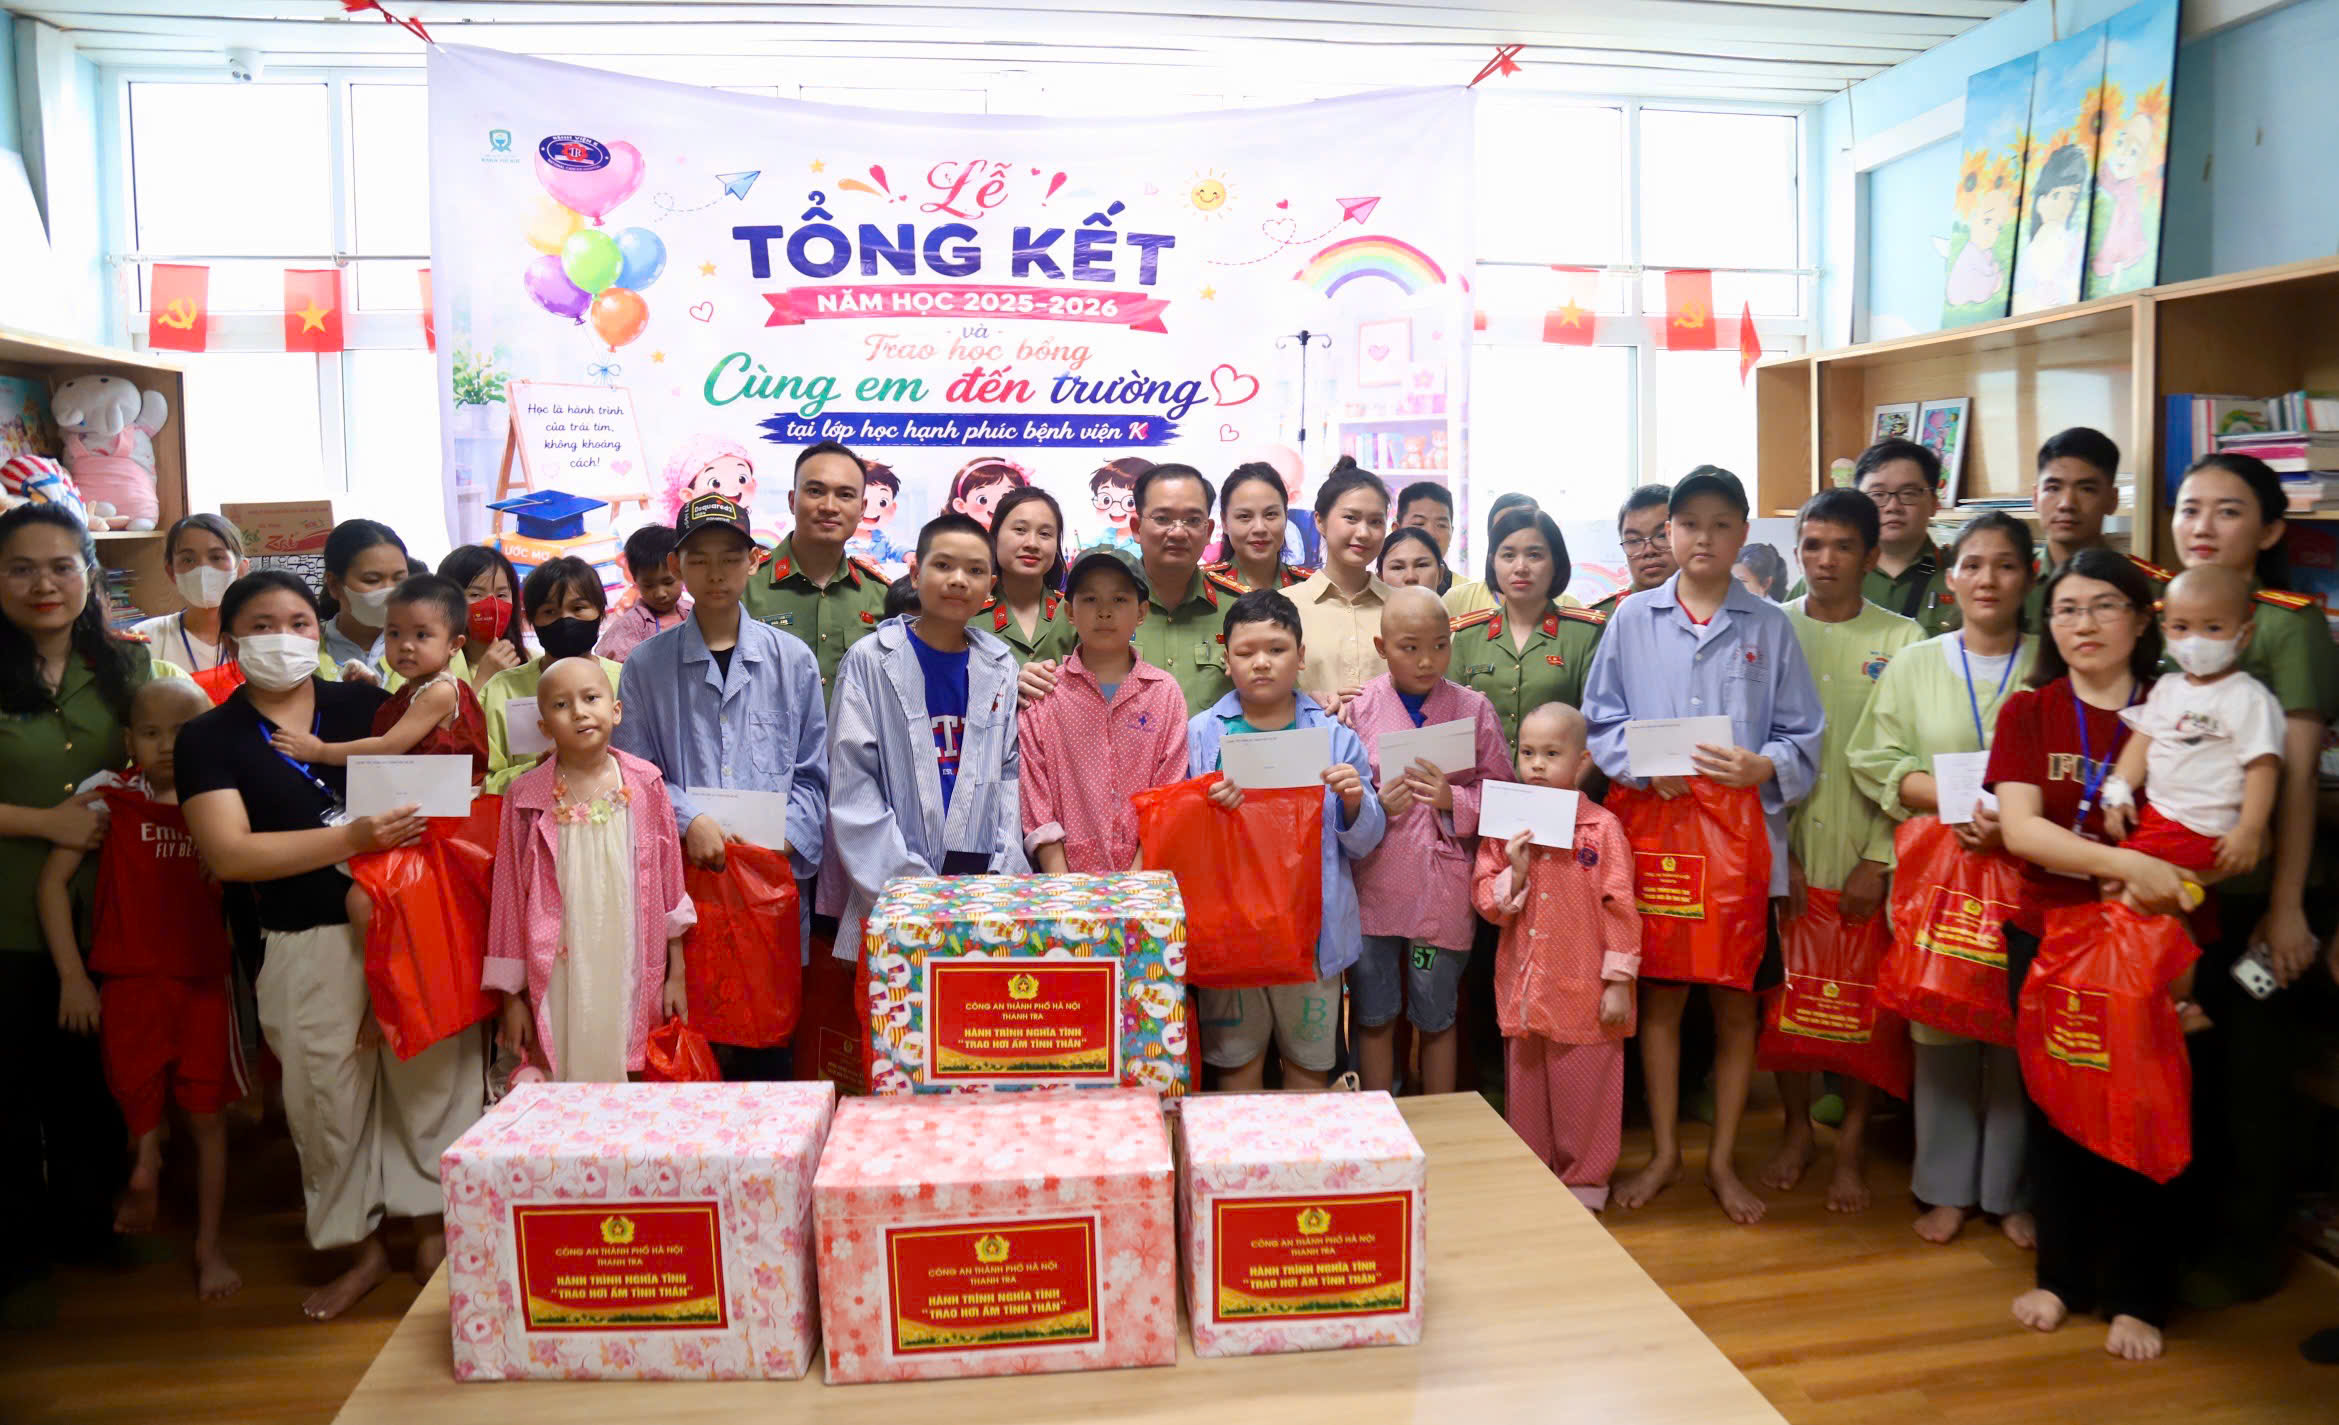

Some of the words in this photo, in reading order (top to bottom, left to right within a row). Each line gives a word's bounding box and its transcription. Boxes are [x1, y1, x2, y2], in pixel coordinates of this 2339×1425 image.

[920, 159, 1012, 220] Lễ
[732, 190, 982, 279] TỔNG
[1012, 200, 1177, 286] KẾT
[818, 289, 886, 313] NĂM
[892, 291, 953, 316] HỌC
[964, 291, 1119, 318] 2025-2026
[962, 322, 989, 339] và
[864, 333, 937, 361] Trao
[948, 336, 1004, 364] học
[1016, 336, 1094, 370] bổng
[703, 352, 841, 417] Cùng
[855, 376, 929, 402] em
[945, 365, 1036, 403] đến
[1050, 369, 1209, 420] trường
[528, 403, 549, 416] Học
[552, 404, 564, 414] là
[567, 404, 595, 415] hành
[598, 405, 624, 415] trình
[545, 422, 566, 432] của
[570, 422, 590, 432] trái
[787, 421, 816, 440] tại
[821, 419, 857, 443] lớp
[860, 419, 899, 441] học
[903, 420, 960, 442] hạnh
[961, 420, 1018, 445] phúc
[1023, 421, 1075, 442] bệnh
[1080, 423, 1124, 443] viện
[1128, 421, 1149, 441] K
[544, 439, 578, 452] không
[569, 457, 601, 468] cách!
[155, 842, 176, 858] FLY
[1412, 946, 1437, 971] 57
[966, 1002, 991, 1010] CÔNG
[1007, 1002, 1032, 1010] THÀNH
[1034, 1001, 1050, 1010] PHỐ
[1066, 1002, 1080, 1011] NỘI
[965, 1027, 991, 1037] HÀNH
[994, 1027, 1023, 1037] TRÌNH
[1026, 1027, 1056, 1036] NGHĨA
[1059, 1027, 1081, 1036] TÌNH
[993, 1039, 1009, 1048] HƠI
[1012, 1038, 1027, 1048] ẤM
[1030, 1039, 1053, 1048] TÌNH
[555, 1247, 583, 1256] CÔNG
[586, 1248, 598, 1256] AN
[601, 1246, 629, 1255] THÀNH
[631, 1245, 649, 1255] PHỐ
[652, 1245, 664, 1255] HÀ
[667, 1245, 683, 1255] NỘI
[597, 1258, 625, 1266] THANH
[628, 1258, 643, 1266] TRA
[1250, 1265, 1279, 1276] HÀNH
[1282, 1263, 1313, 1275] TRÌNH
[1316, 1262, 1349, 1273] NGHĨA
[1352, 1261, 1376, 1272] TÌNH
[557, 1275, 586, 1285] HÀNH
[590, 1275, 622, 1285] TRÌNH
[625, 1274, 658, 1284] NGHĨA
[662, 1273, 686, 1284] TÌNH
[971, 1277, 999, 1285] THANH
[589, 1288, 608, 1298] HƠI
[611, 1287, 628, 1298] ẤM
[632, 1287, 656, 1298] TÌNH
[928, 1295, 958, 1306] HÀNH
[962, 1293, 994, 1304] TRÌNH
[998, 1291, 1031, 1302] NGHĨA
[1035, 1288, 1060, 1299] TÌNH
[961, 1307, 979, 1318] HƠI
[983, 1305, 1000, 1316] ẤM
[1004, 1304, 1028, 1315] TÌNH
